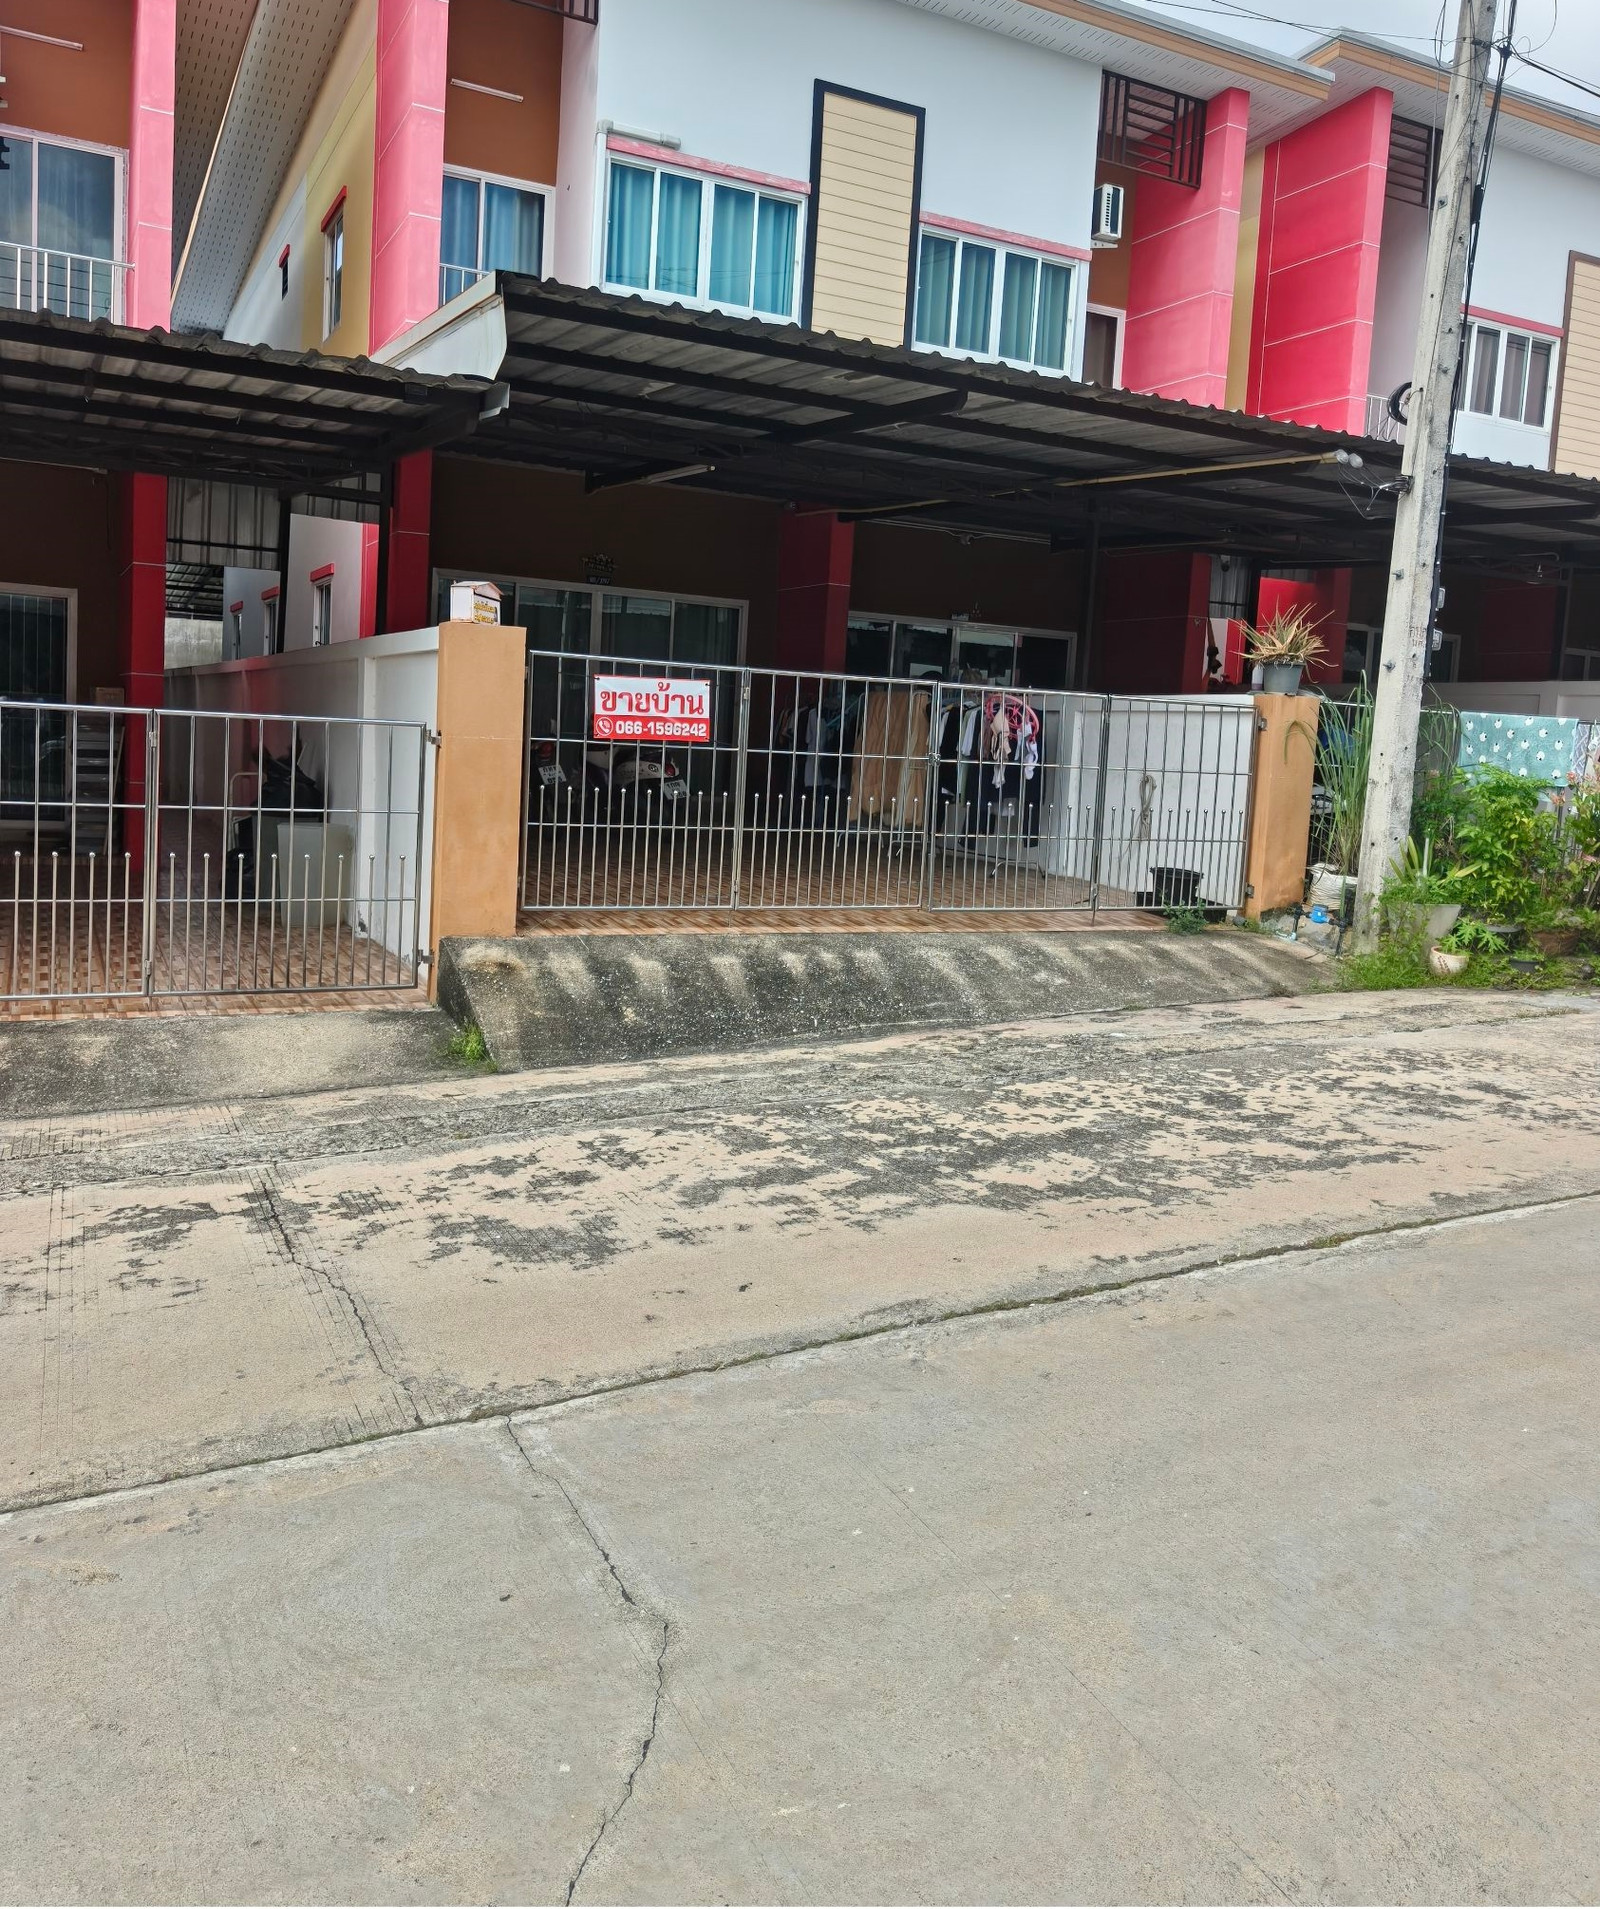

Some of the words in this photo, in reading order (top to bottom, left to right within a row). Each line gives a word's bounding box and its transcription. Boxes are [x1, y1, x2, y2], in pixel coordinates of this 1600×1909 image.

[600, 681, 704, 715] ขายบ้าน
[615, 720, 707, 737] 066-1596242
